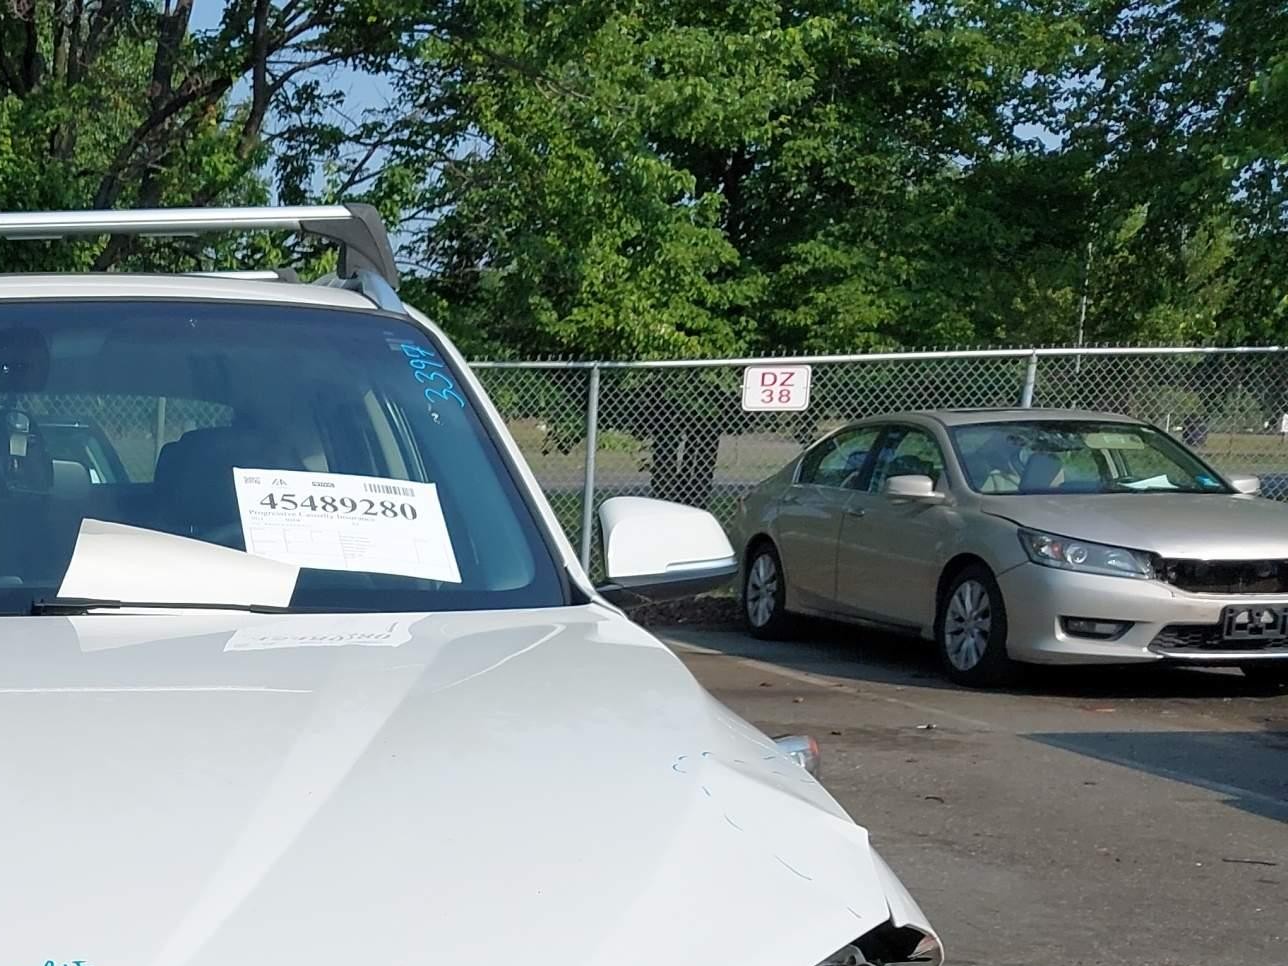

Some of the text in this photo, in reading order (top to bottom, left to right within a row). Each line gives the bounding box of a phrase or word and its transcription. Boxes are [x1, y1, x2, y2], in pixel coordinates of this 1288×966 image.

[760, 371, 796, 387] DZ
[760, 388, 791, 404] 38
[259, 492, 418, 521] 45489280
